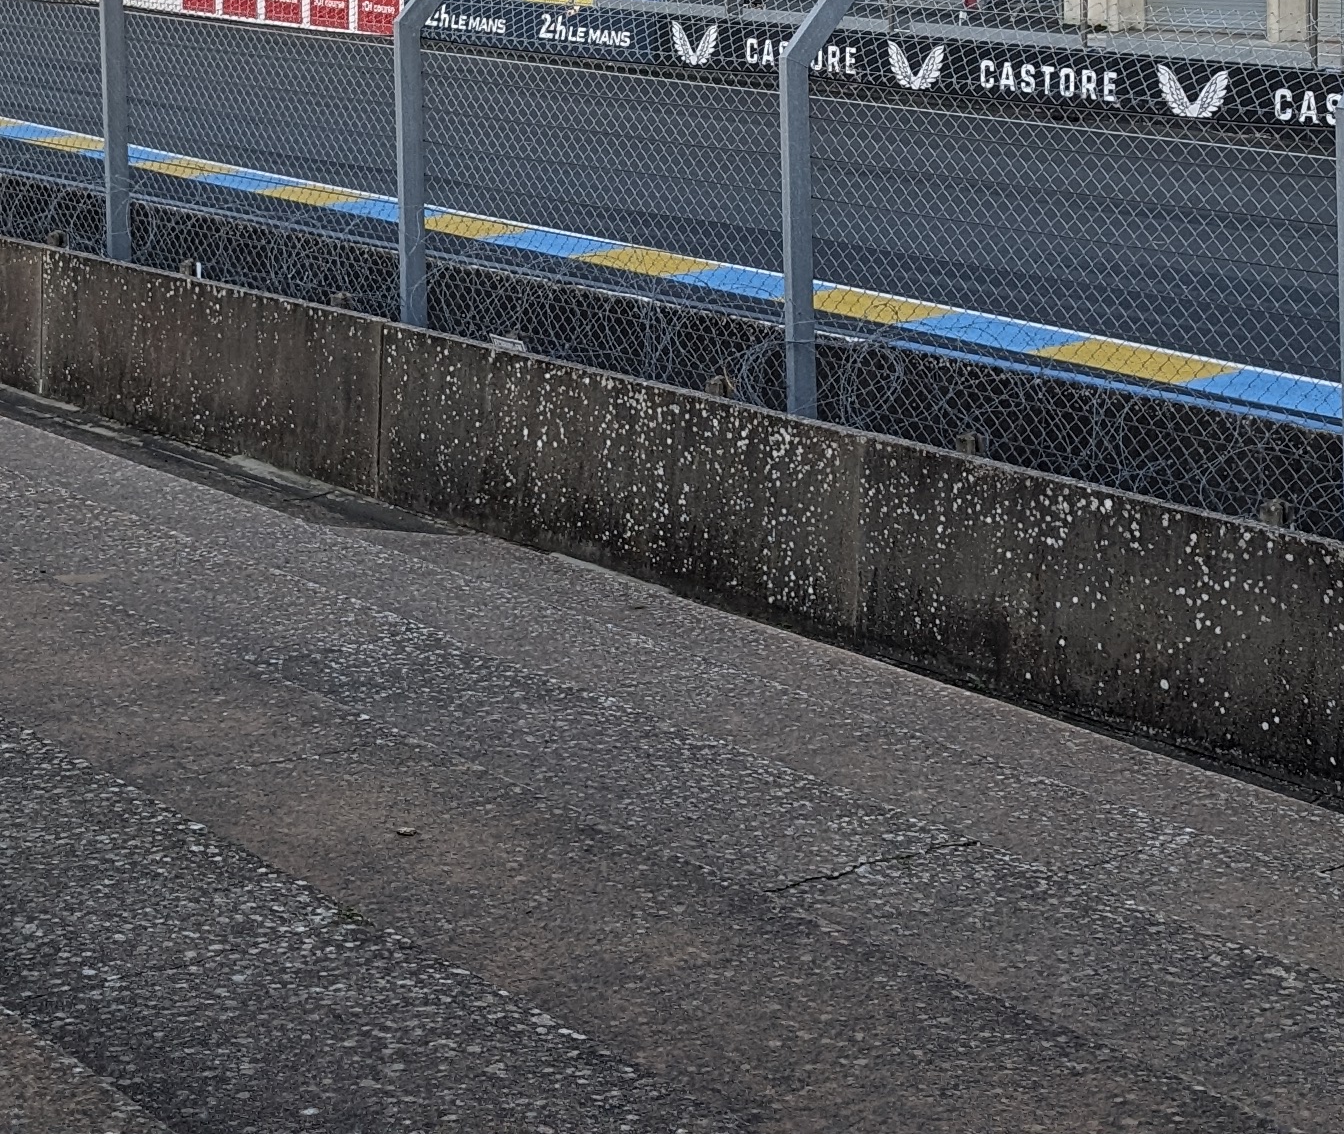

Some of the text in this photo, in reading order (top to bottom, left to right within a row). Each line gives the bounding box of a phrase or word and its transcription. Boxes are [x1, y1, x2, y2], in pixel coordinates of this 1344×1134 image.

[451, 15, 467, 30] LE
[468, 16, 506, 34] MANS
[568, 26, 586, 43] LE
[588, 27, 631, 47] MANS
[746, 38, 856, 74] CARE
[980, 59, 1118, 104] CASTORE
